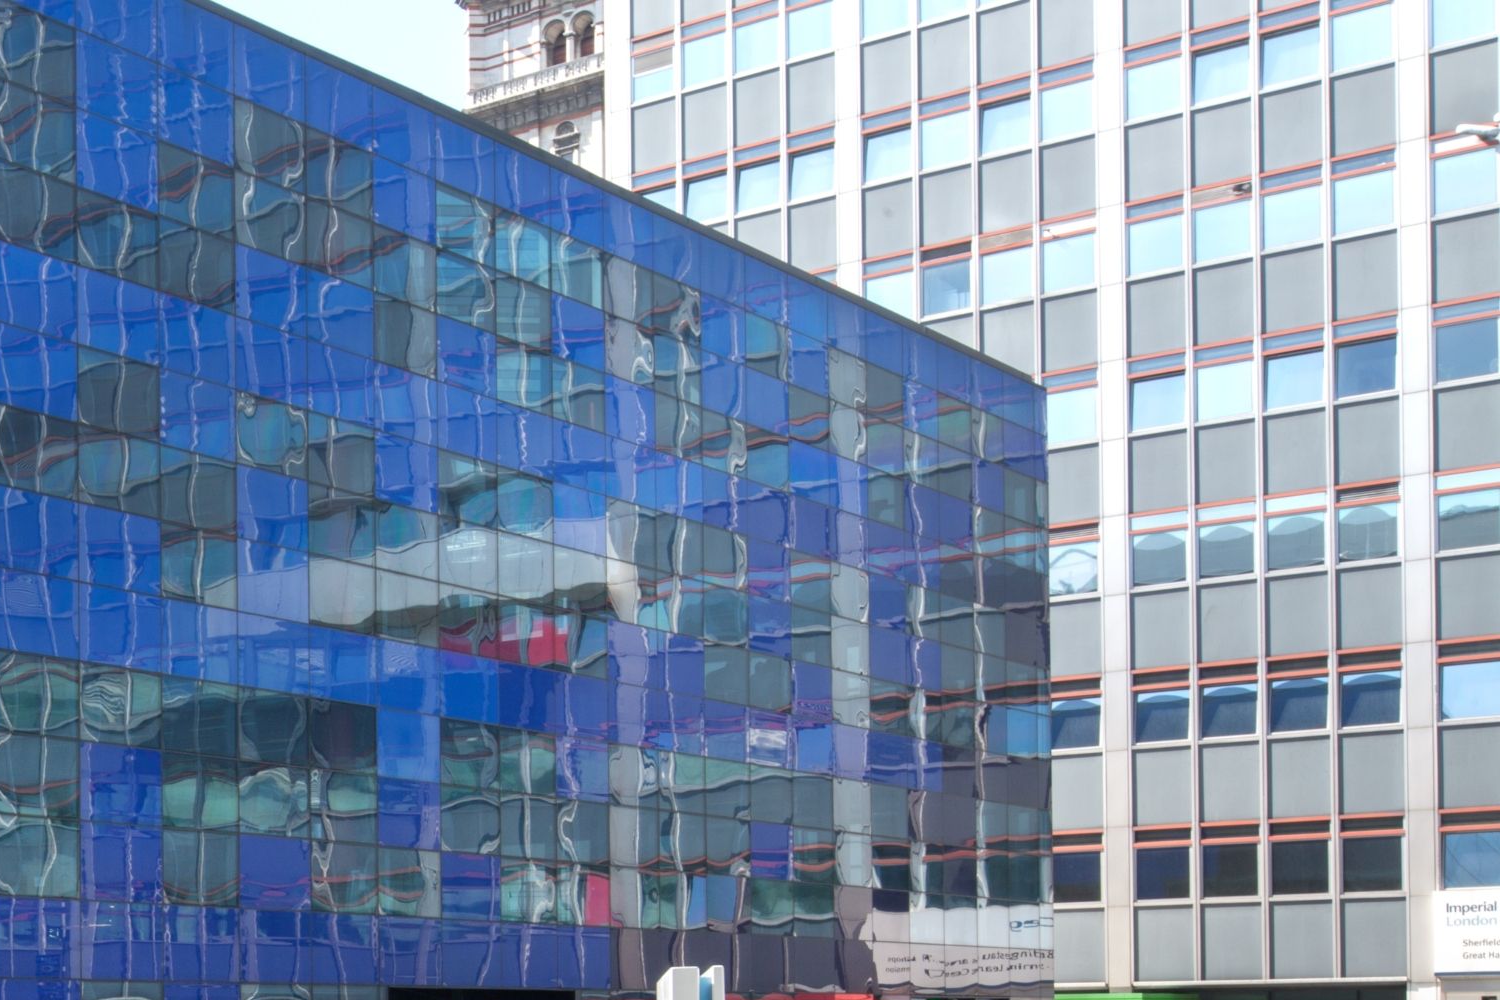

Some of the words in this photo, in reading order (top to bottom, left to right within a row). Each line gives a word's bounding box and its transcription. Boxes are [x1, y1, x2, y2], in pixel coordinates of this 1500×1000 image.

[1446, 901, 1498, 915] Imperial
[1446, 916, 1498, 927] London
[1462, 951, 1486, 960] Great
